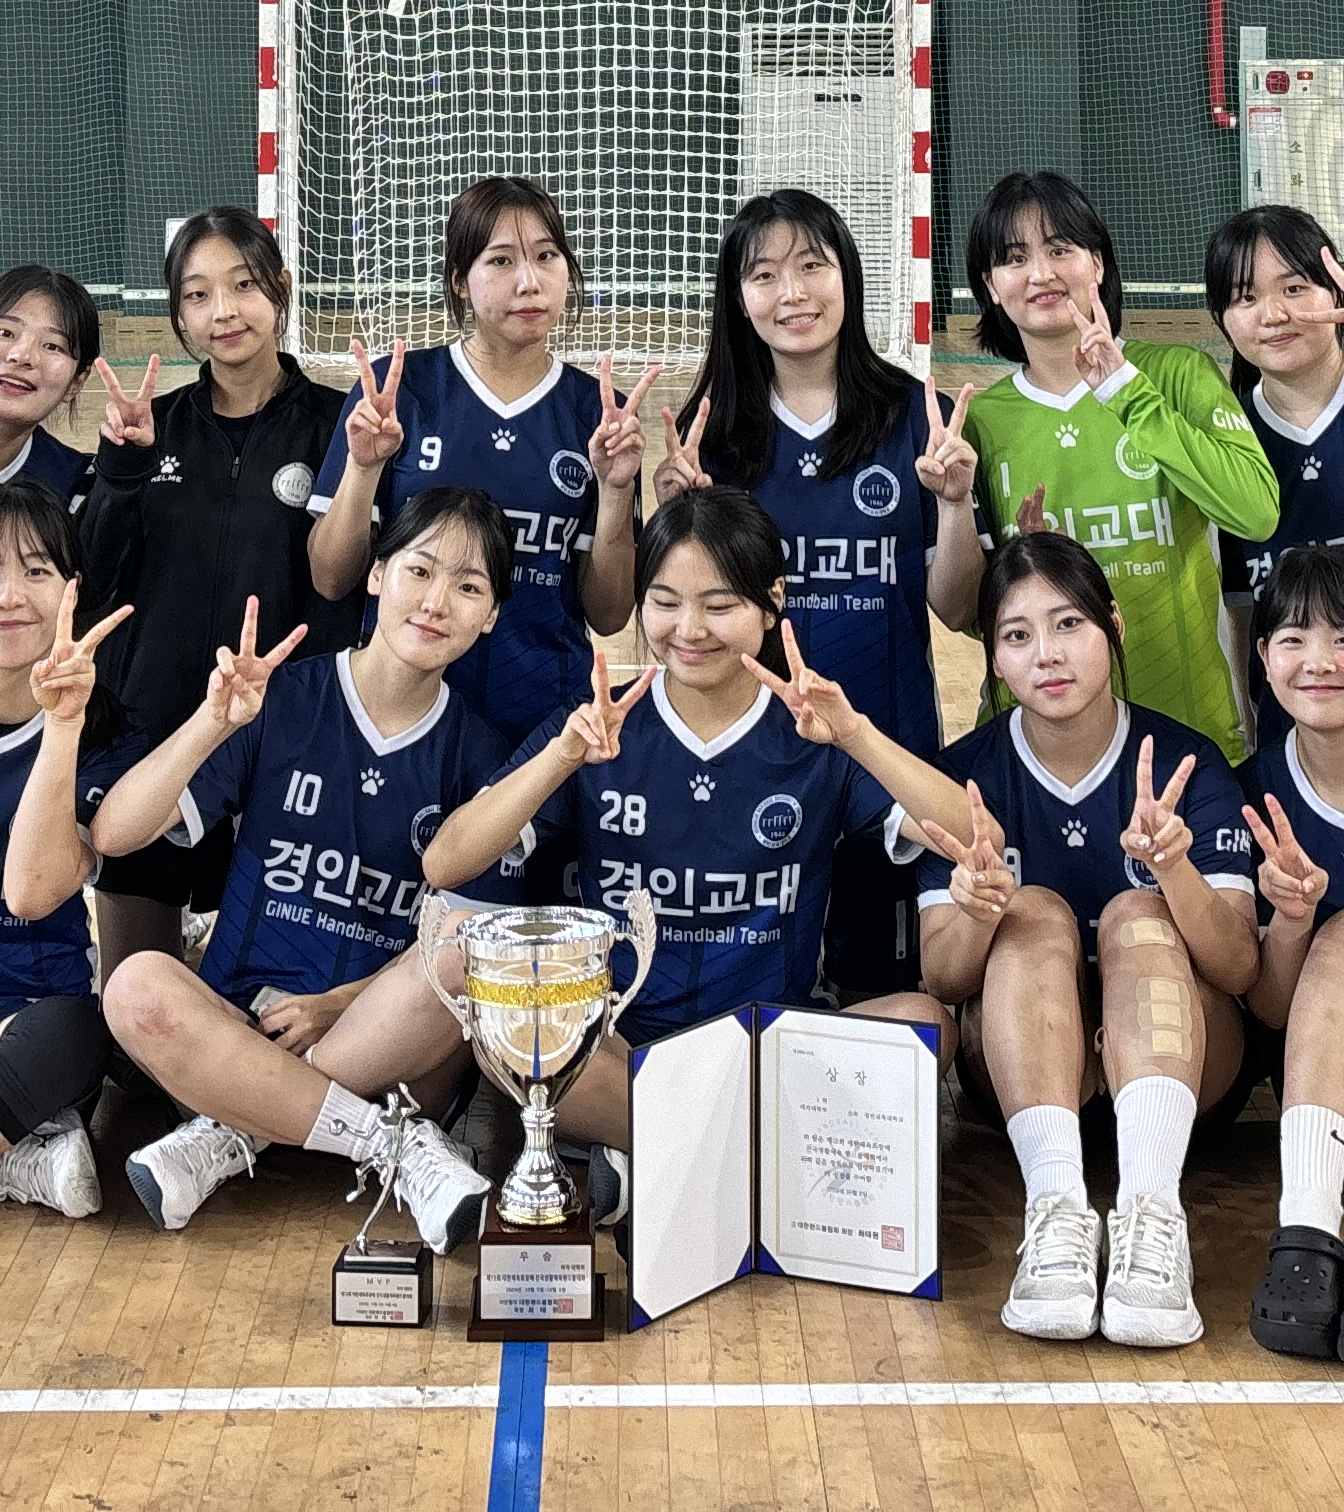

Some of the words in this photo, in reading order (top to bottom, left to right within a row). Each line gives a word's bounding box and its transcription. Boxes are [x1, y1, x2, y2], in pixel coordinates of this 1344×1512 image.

[419, 436, 442, 471] 9
[780, 536, 898, 585] 인교대
[1126, 560, 1167, 579] Team
[528, 568, 562, 588] Team
[844, 595, 885, 611] Team
[283, 769, 323, 817] 10
[599, 789, 647, 837] 28
[599, 858, 801, 918] 경인교대
[265, 899, 313, 926] GINUE
[662, 925, 734, 945] Handball
[739, 926, 781, 945] Team
